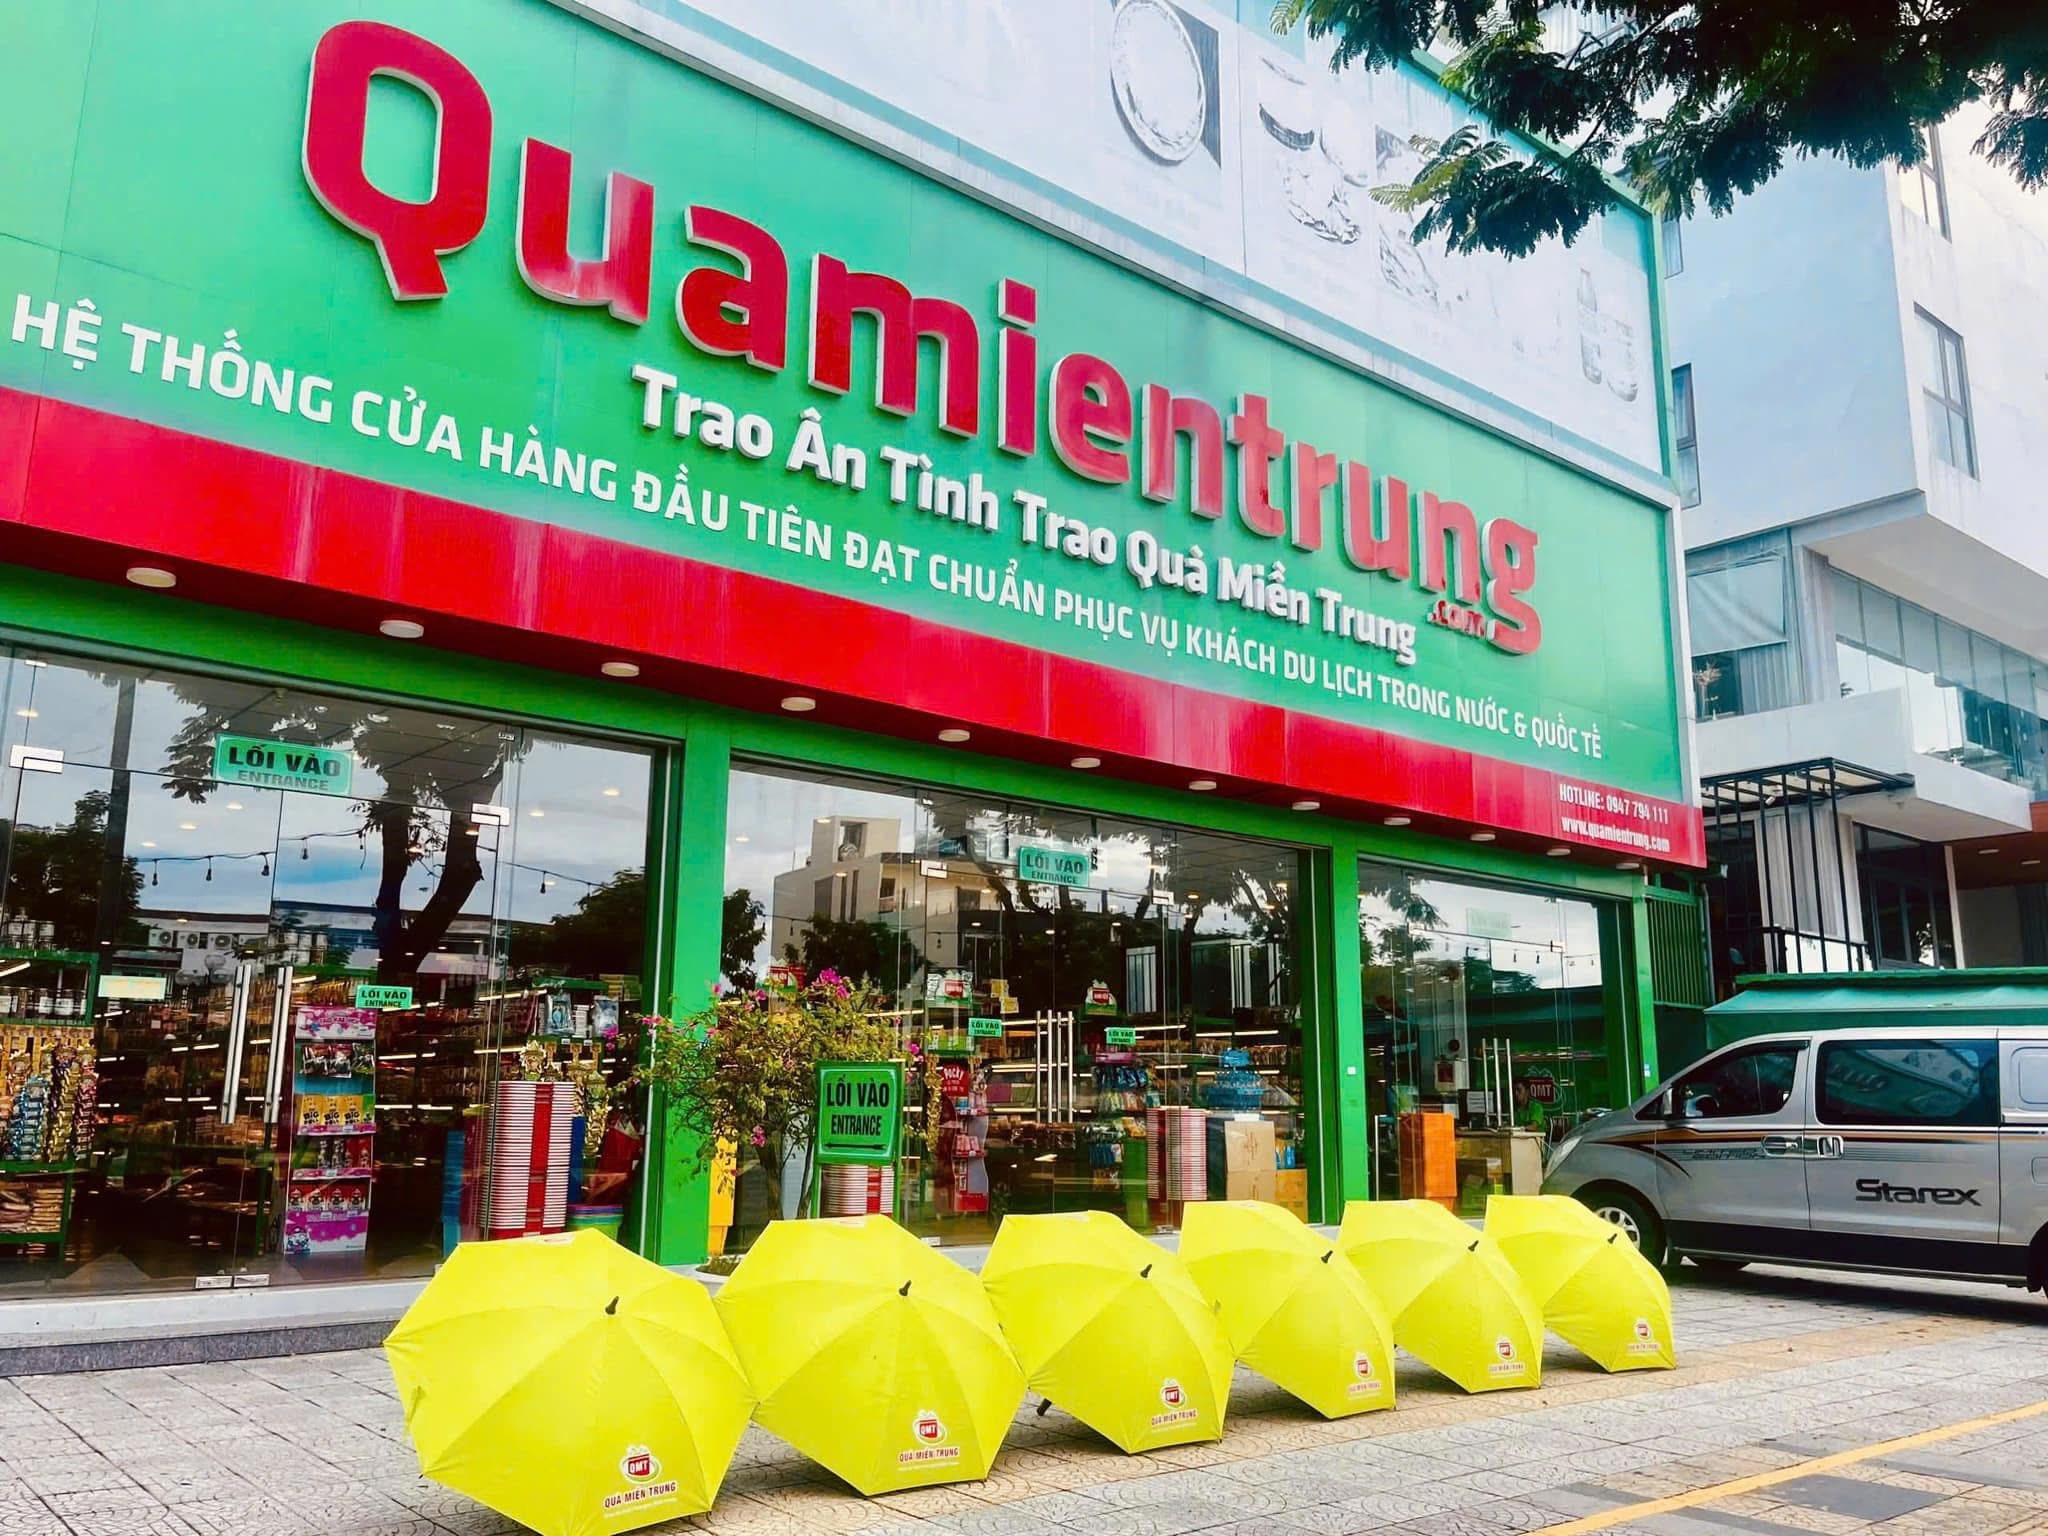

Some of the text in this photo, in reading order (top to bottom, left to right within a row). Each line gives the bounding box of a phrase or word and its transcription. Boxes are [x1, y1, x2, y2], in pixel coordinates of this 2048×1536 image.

[301, 20, 1541, 655] Quamientrung
[11, 294, 1602, 759] HỆ THỐNG CỬA HÀNG ĐẦU TIÊN ĐẠT CHUẨN PHỤC VỤ KHÁCH DU LỊCH TRONG NƯỚC & QUỐC TẾ
[632, 364, 1417, 665] Trao Ân Tình Trao Quà Miền Trung
[229, 744, 341, 776] LỐI VÀO
[237, 770, 329, 791] ENTRANCE
[1560, 784, 1668, 824] HOTLINE: 0947 794 111
[1561, 816, 1670, 852] www.quamientrung.com
[1032, 871, 1079, 884] ENTRANCE
[827, 1074, 890, 1108] LỐI VÀO
[1530, 1084, 1552, 1097] QMT
[831, 1114, 882, 1136] ENTRANCE
[1856, 1178, 1982, 1207] Starex
[649, 1482, 676, 1496] TRUNG
